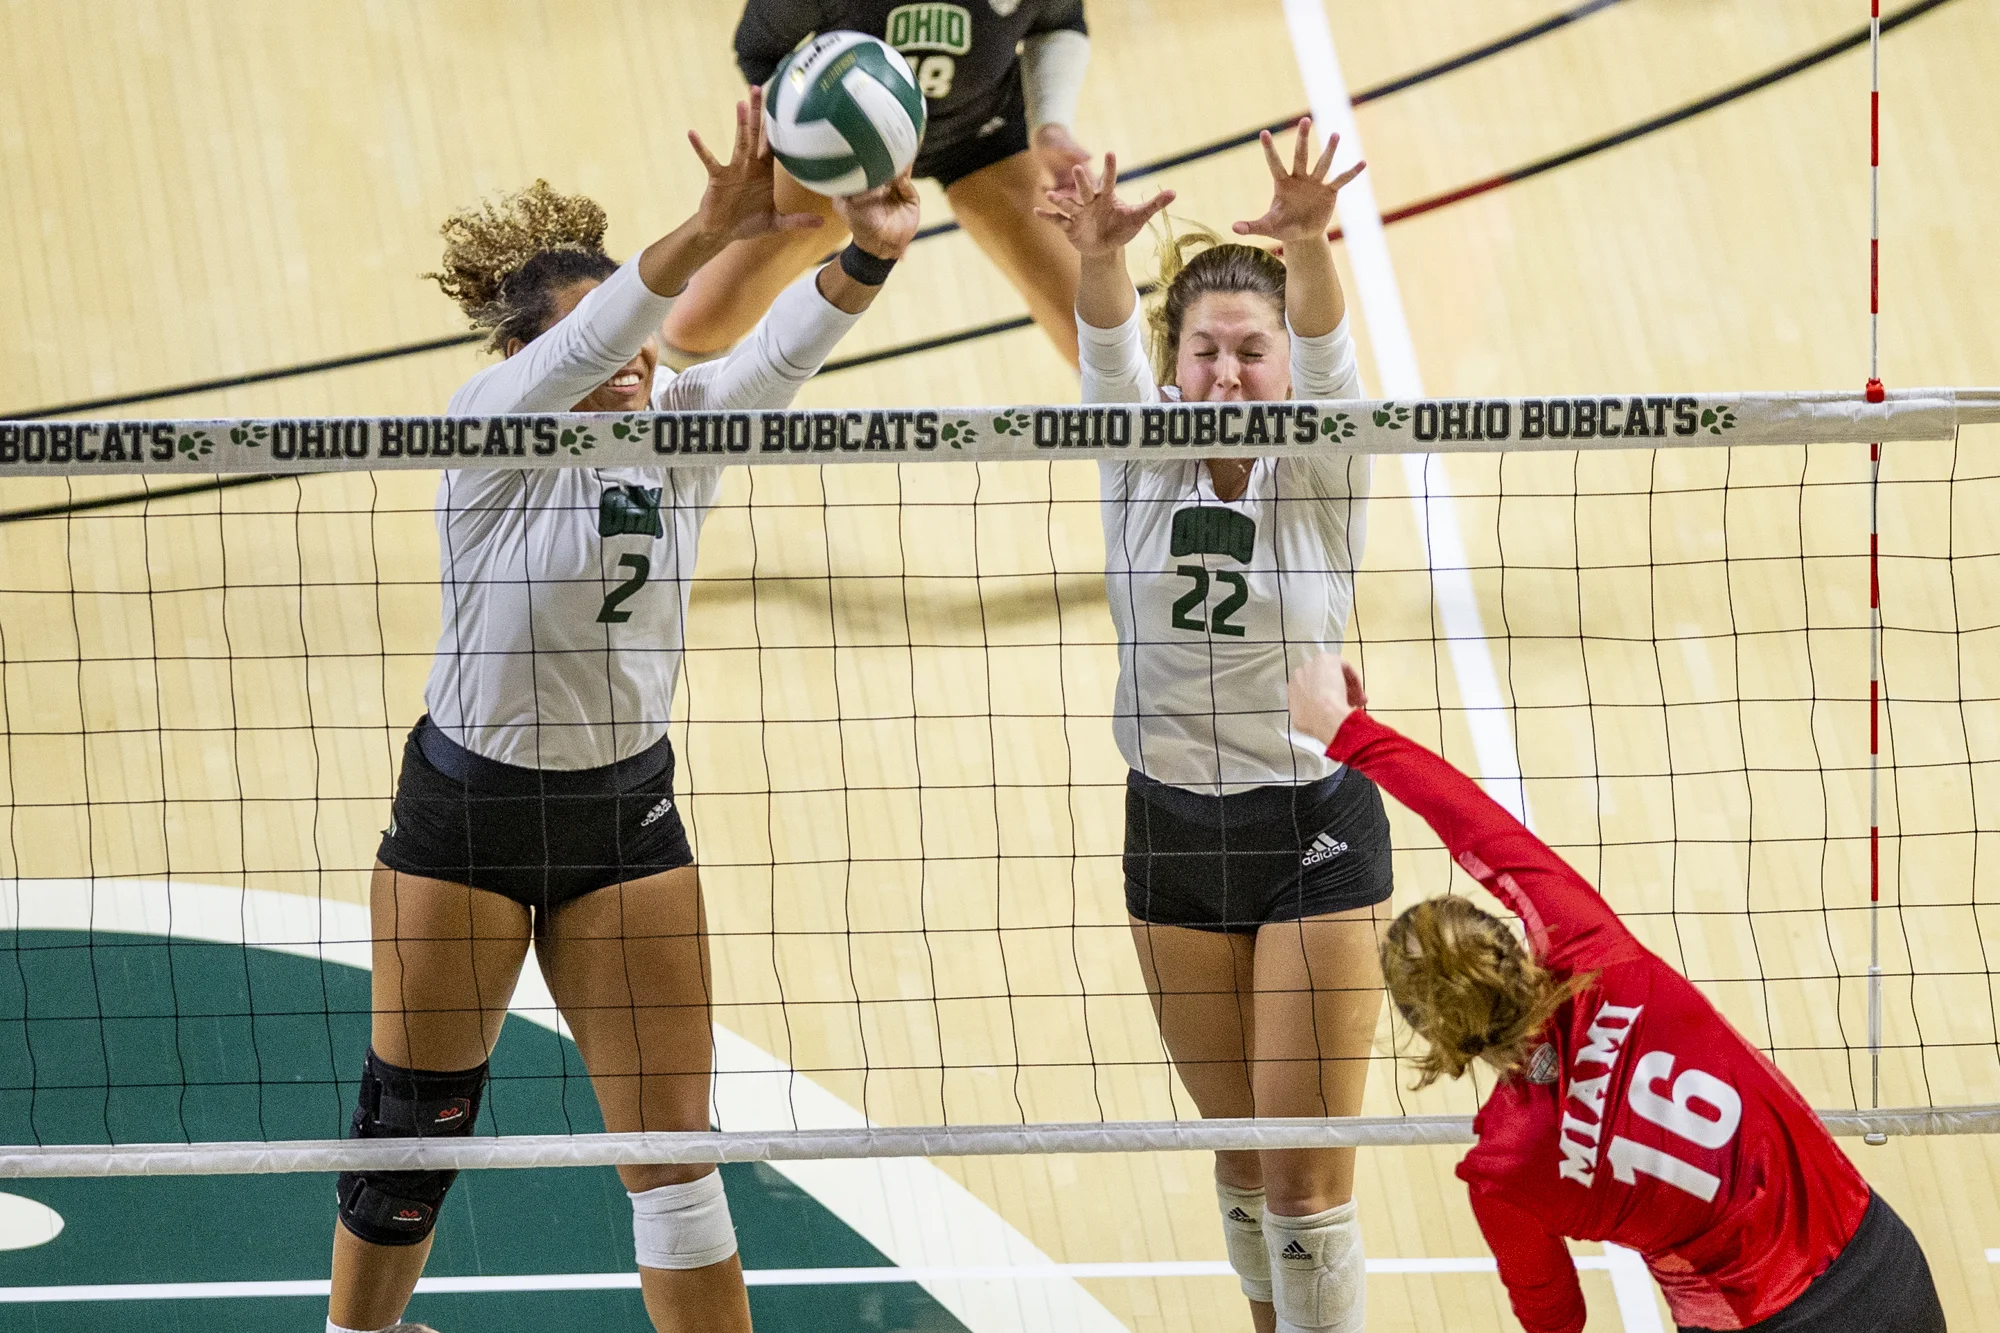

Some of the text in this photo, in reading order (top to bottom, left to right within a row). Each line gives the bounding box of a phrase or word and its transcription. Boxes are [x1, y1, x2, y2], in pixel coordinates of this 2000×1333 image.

[888, 5, 969, 52] OHIO
[0, 396, 1699, 463] BOBCATS OHIO BOBCATS OHIO BOBCATS OHIO BOBCATS OHIO BOBCATS
[596, 553, 650, 623] 2
[1172, 564, 1249, 637] 22
[1302, 842, 1348, 866] adidas
[1558, 1000, 1644, 1189] MIAMI
[1606, 1050, 1743, 1204] 16
[1281, 1251, 1312, 1260] adidas
